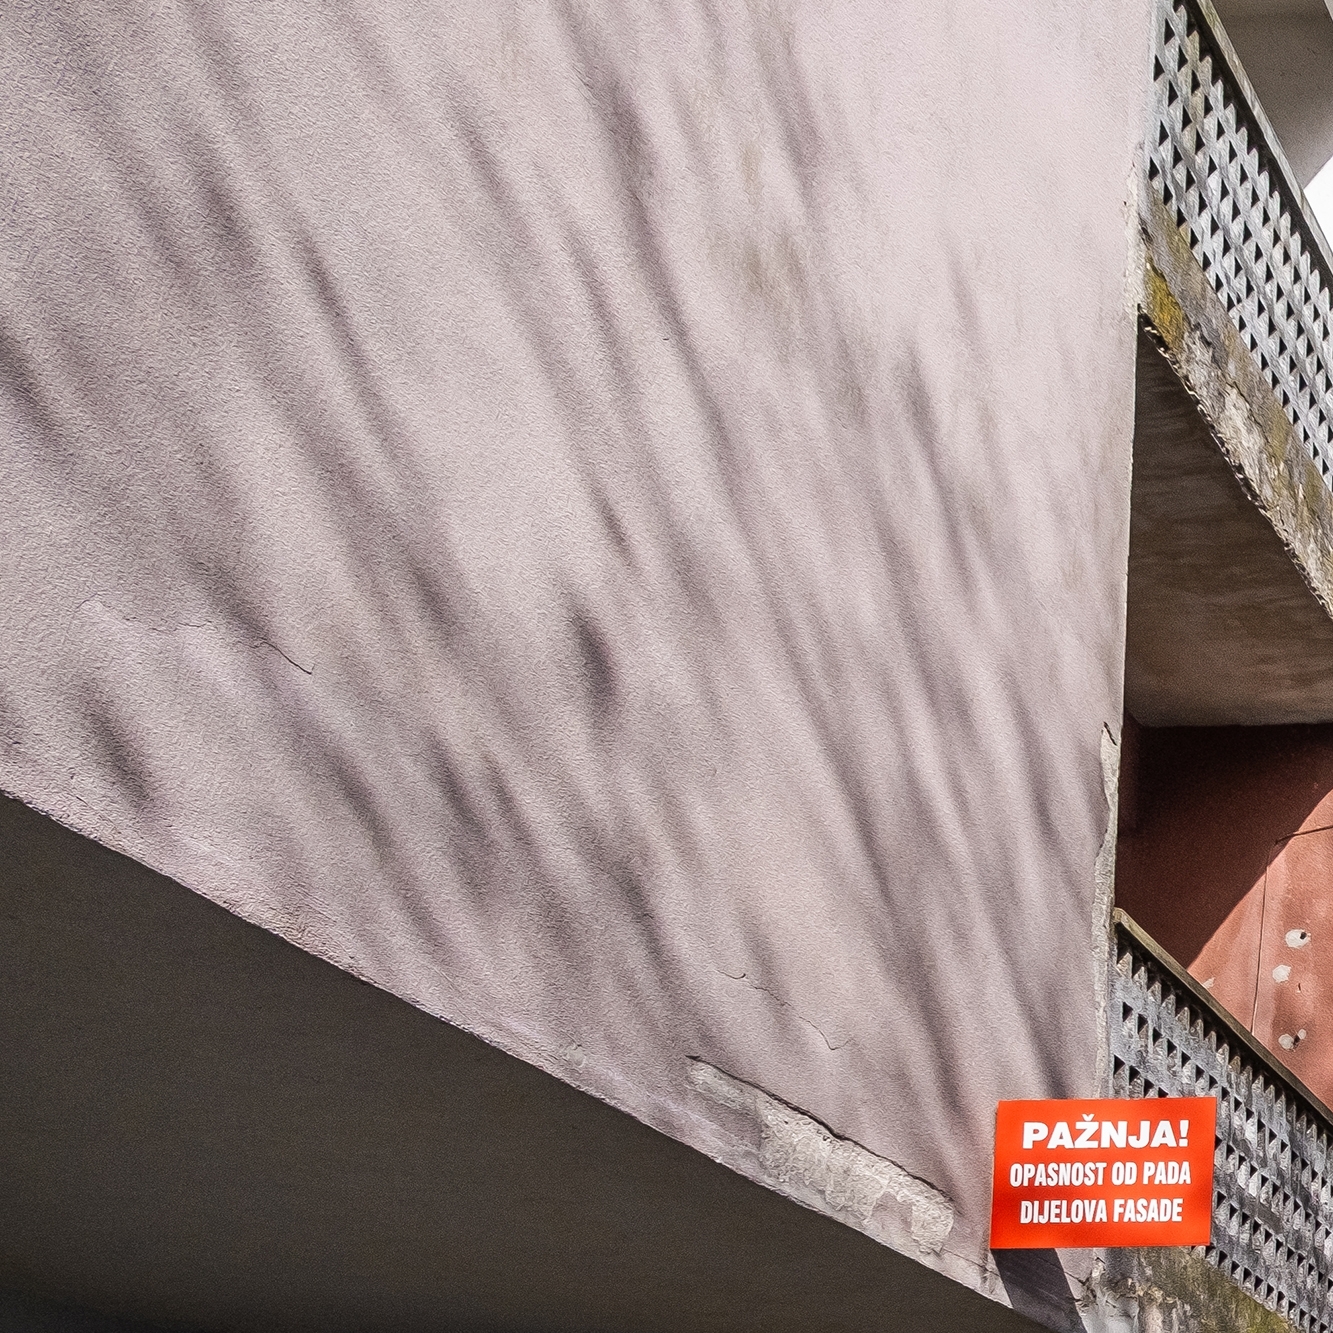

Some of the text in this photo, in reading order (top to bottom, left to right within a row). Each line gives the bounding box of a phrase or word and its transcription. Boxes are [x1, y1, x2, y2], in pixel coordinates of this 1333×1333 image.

[1022, 1113, 1189, 1149] PAŽNJA!
[1009, 1161, 1191, 1187] OPASNOST OD PADA
[1020, 1198, 1183, 1224] DIJELOVA FASADE
